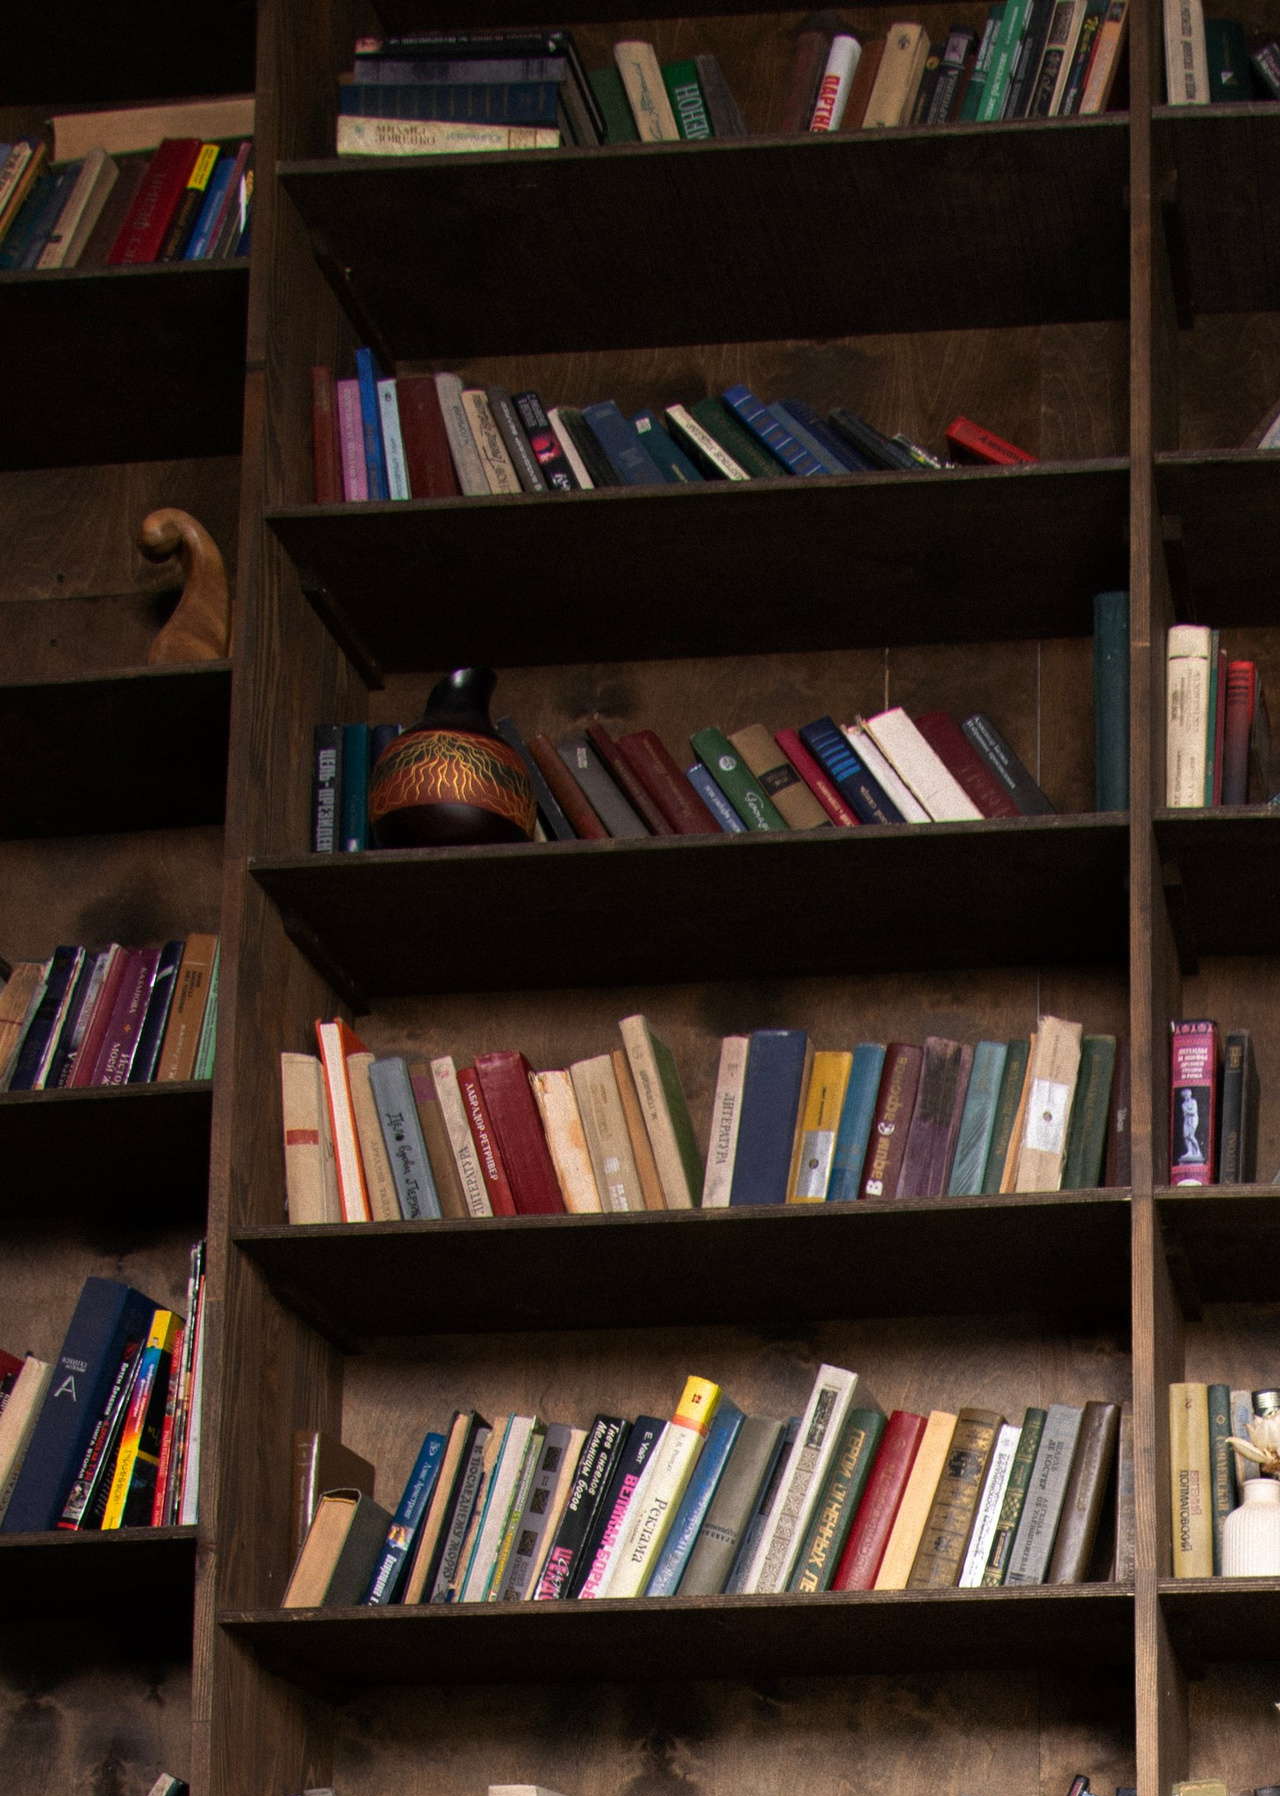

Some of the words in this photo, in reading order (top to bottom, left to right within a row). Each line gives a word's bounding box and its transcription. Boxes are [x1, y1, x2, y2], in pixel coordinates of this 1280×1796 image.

[317, 748, 337, 851] ЦЕЛЬ-ПРЕЗИДЕН
[126, 966, 150, 1014] КАЗАНОВА
[103, 1041, 122, 1075] моей
[461, 1081, 502, 1181] ЛАБРАДОР-РЕТРИВЕР
[712, 1092, 737, 1165] ЛИТЕРАТУРА
[452, 1145, 490, 1216] ЛИТЕРАТУРА
[88, 1419, 105, 1446] КНИГА
[578, 1420, 609, 1476] Мельницы
[601, 1422, 621, 1449] Гнев
[633, 1441, 649, 1463] Уайт
[837, 1427, 866, 1479] ГЕРОИ
[1048, 1439, 1056, 1450] ДЕ
[75, 1447, 94, 1479] ВТОРАЯ
[584, 1451, 610, 1495] ангелов
[1036, 1452, 1054, 1490] КОСТЕР
[1049, 1440, 1065, 1472] ШАРЛЬ
[401, 1480, 424, 1519] Армстронг
[450, 1455, 482, 1538] ПОСЛЕДНЕМУ
[568, 1479, 589, 1511] богов
[599, 1472, 639, 1548] ВЕЛИКАЯ
[1178, 1470, 1191, 1551] ДОЛМАТОВСКИЙ
[1190, 1470, 1200, 1514] ЕВГЕНИЙ
[630, 1497, 667, 1564] Реклама
[808, 1482, 848, 1566] ОГНЕННЫХ
[440, 1539, 461, 1579] МОРЮ
